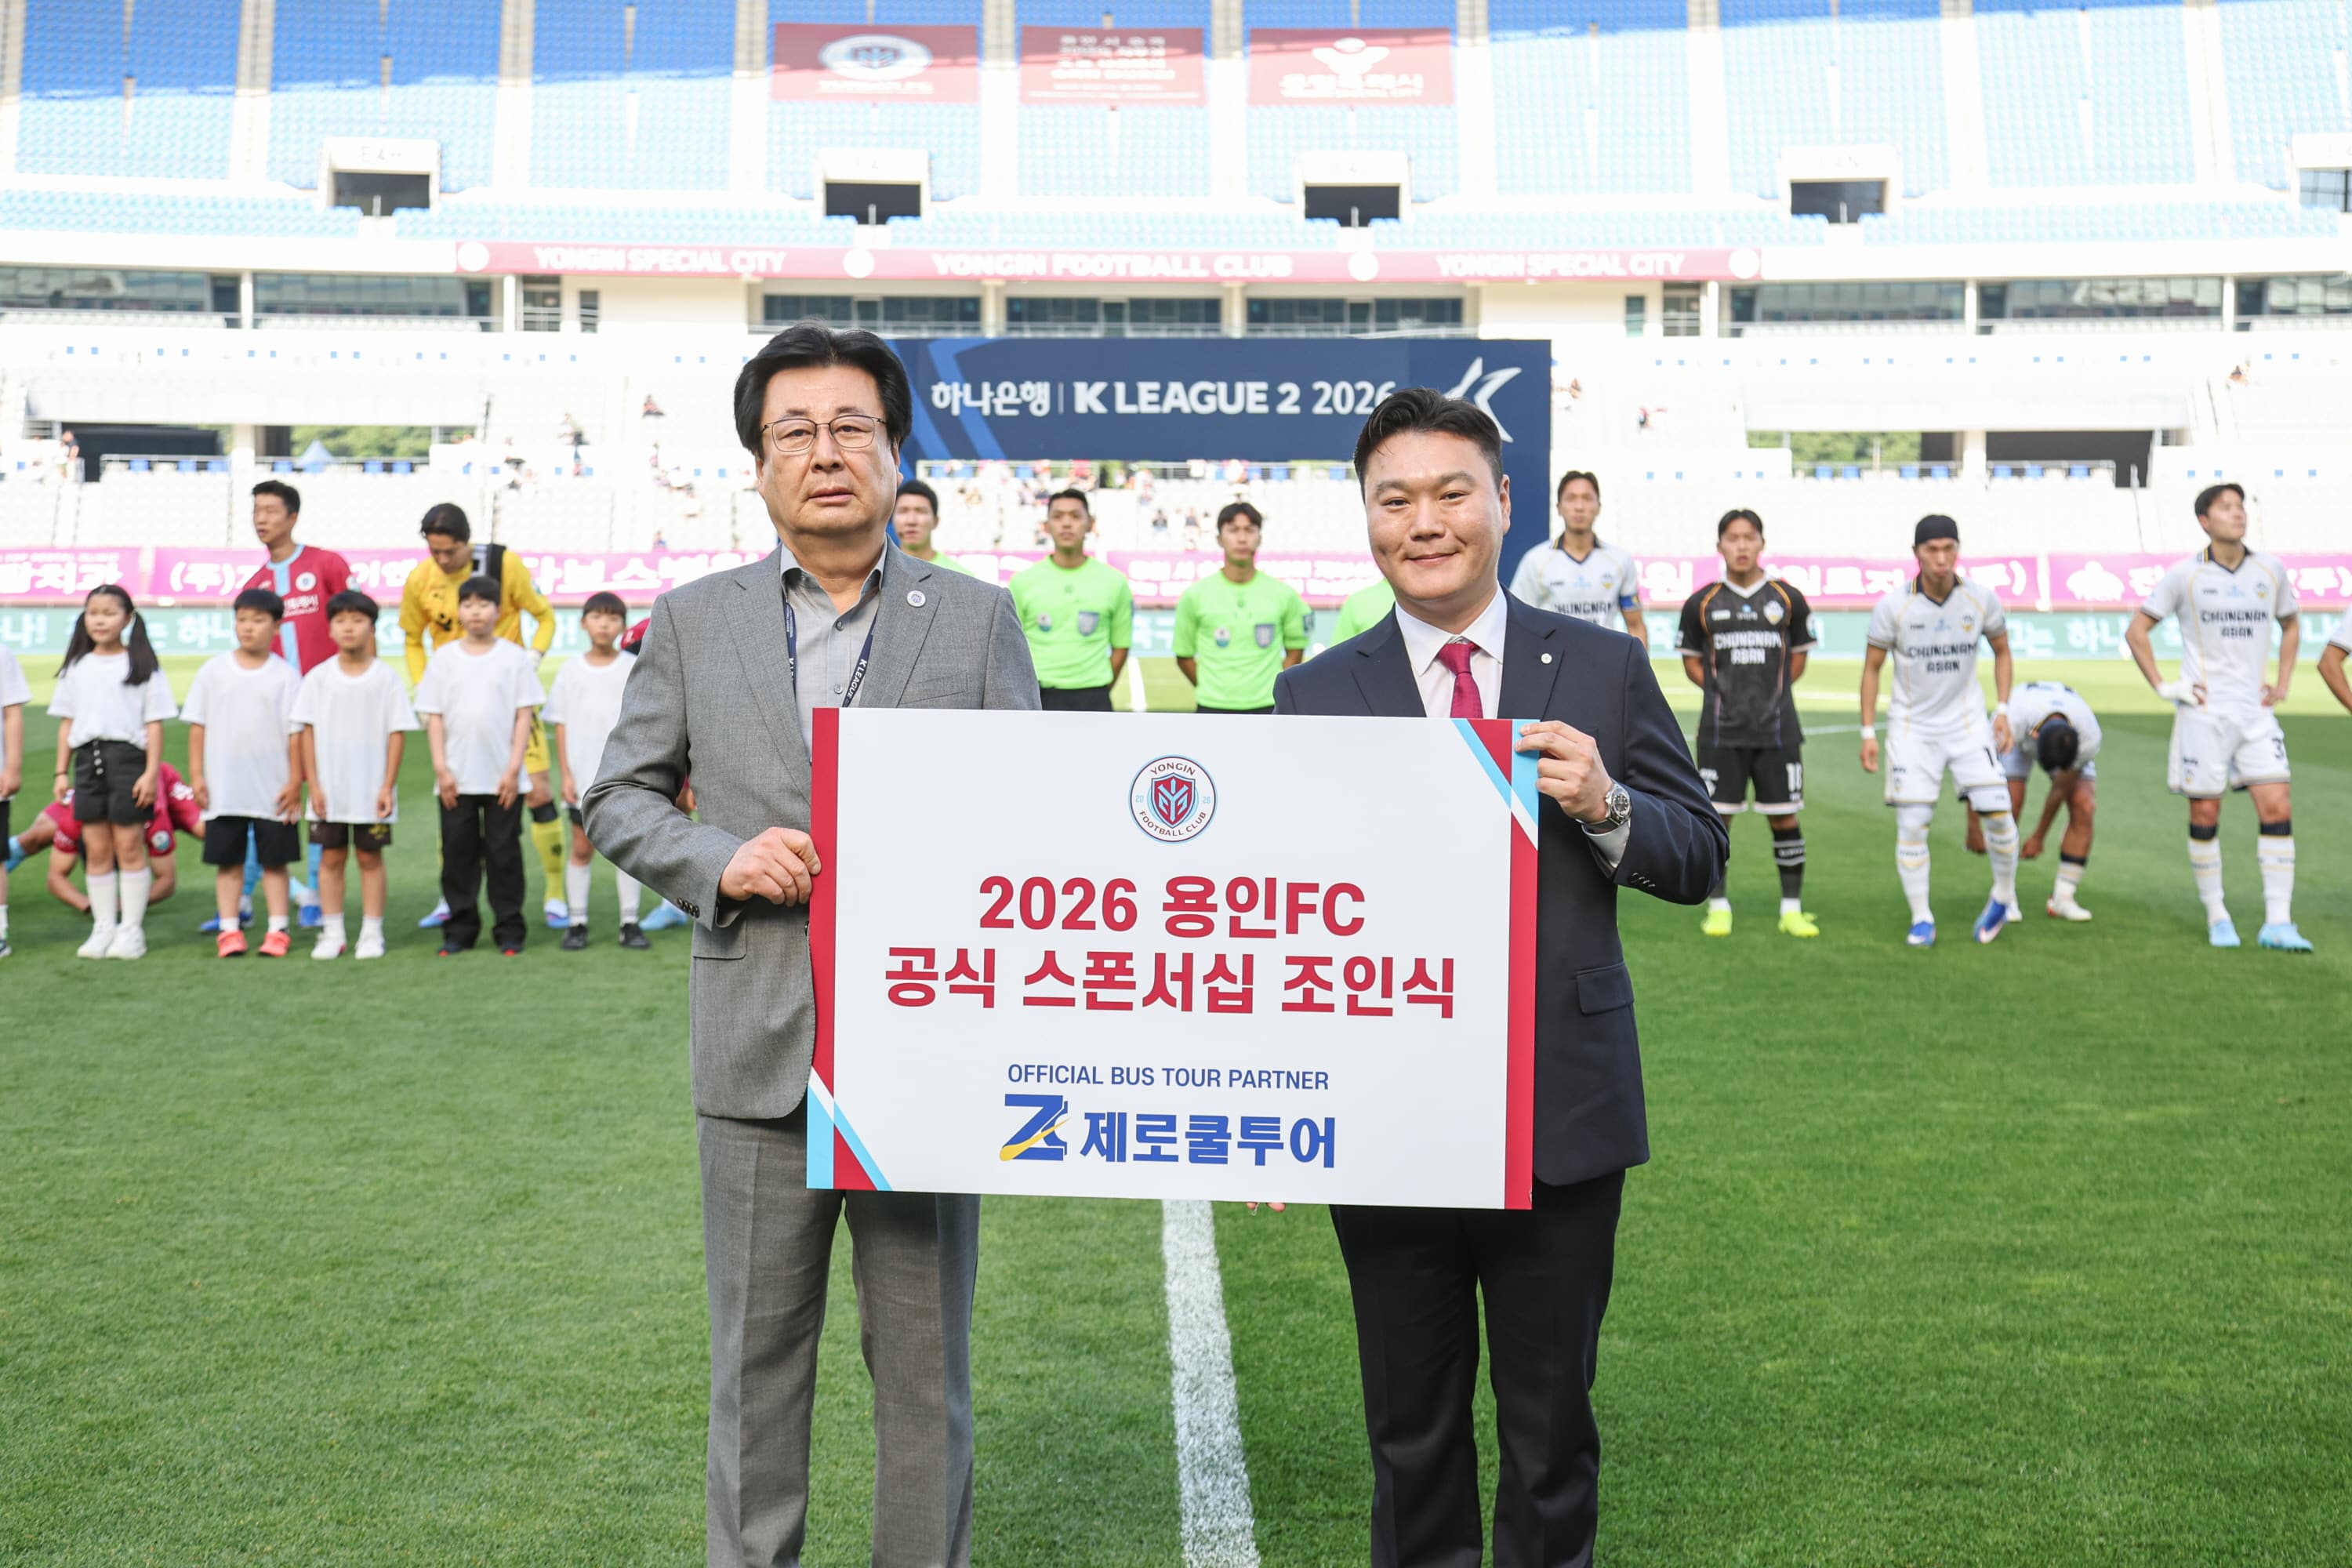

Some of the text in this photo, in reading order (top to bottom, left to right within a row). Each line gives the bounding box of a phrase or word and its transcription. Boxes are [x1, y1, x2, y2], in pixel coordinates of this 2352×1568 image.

[533, 245, 786, 270] YONGIN SPECIAL CITY
[931, 252, 1293, 278] YONGIN FOOTBALL CLUB
[1436, 253, 1686, 276] YONGIN SPECIAL CITY
[931, 380, 1051, 417] 하나은행
[1074, 381, 1108, 414] K
[1114, 381, 1269, 415] LEAGUE
[1276, 381, 1301, 414] 2
[1714, 630, 1782, 651] CHUNGNAM
[847, 666, 866, 700] LEAGUE
[1150, 762, 1196, 776] YONGIN
[1139, 811, 1207, 837] FOOTBALL CLUB
[979, 876, 1366, 938] 2026 용인FC
[885, 946, 1454, 1018] 공식 스폰서십 조인식
[1007, 1063, 1329, 1091] OFFICIAL BUS TOUR PARTNER
[1080, 1111, 1336, 1169] 제로쿨투어
